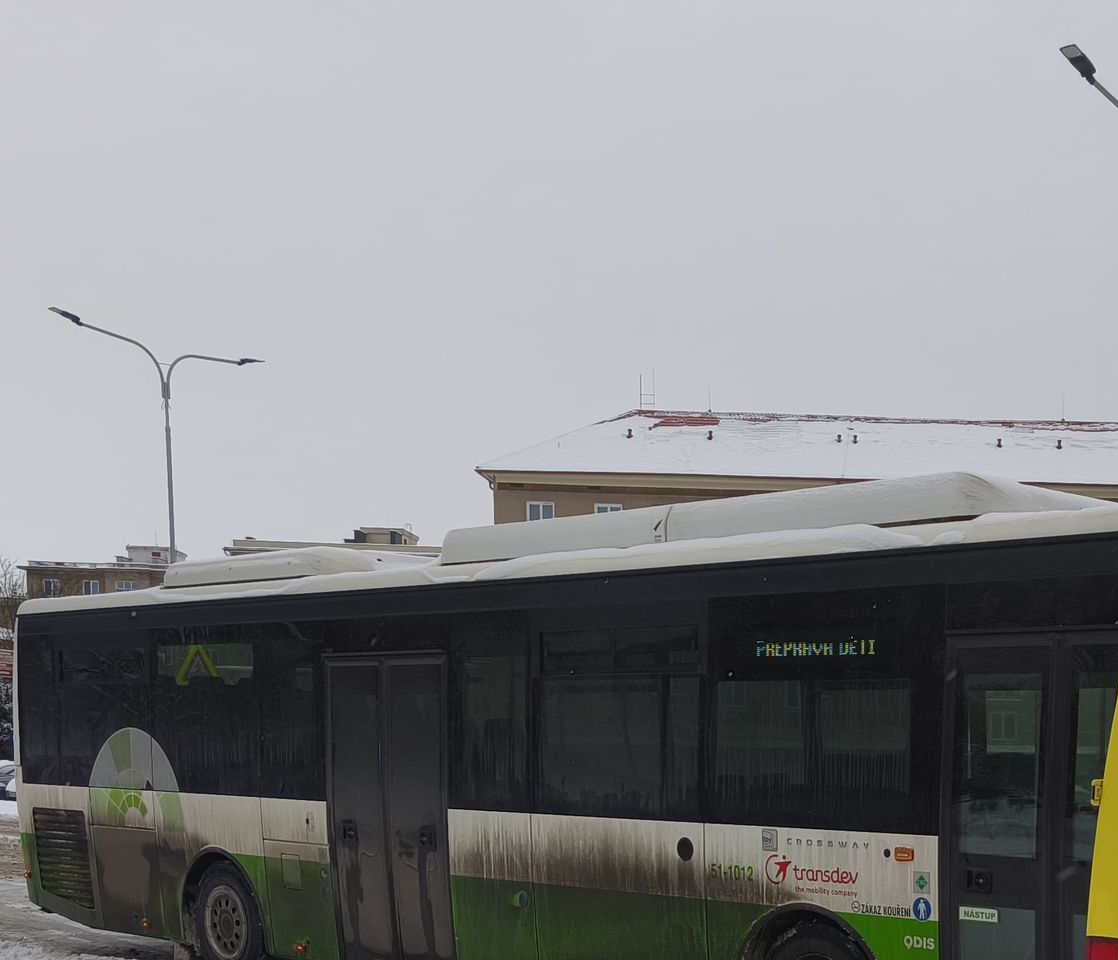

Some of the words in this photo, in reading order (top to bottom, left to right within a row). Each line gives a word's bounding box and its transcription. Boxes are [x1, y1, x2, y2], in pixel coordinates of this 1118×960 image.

[786, 837, 871, 850] CROSSWAY
[793, 865, 859, 885] transdev
[794, 886, 805, 894] the
[806, 887, 830, 896] mobility
[831, 889, 858, 899] company
[861, 902, 882, 915] ZÁKAZ
[883, 904, 911, 918] KOUŘENÍ
[963, 908, 996, 921] NÁSTUP
